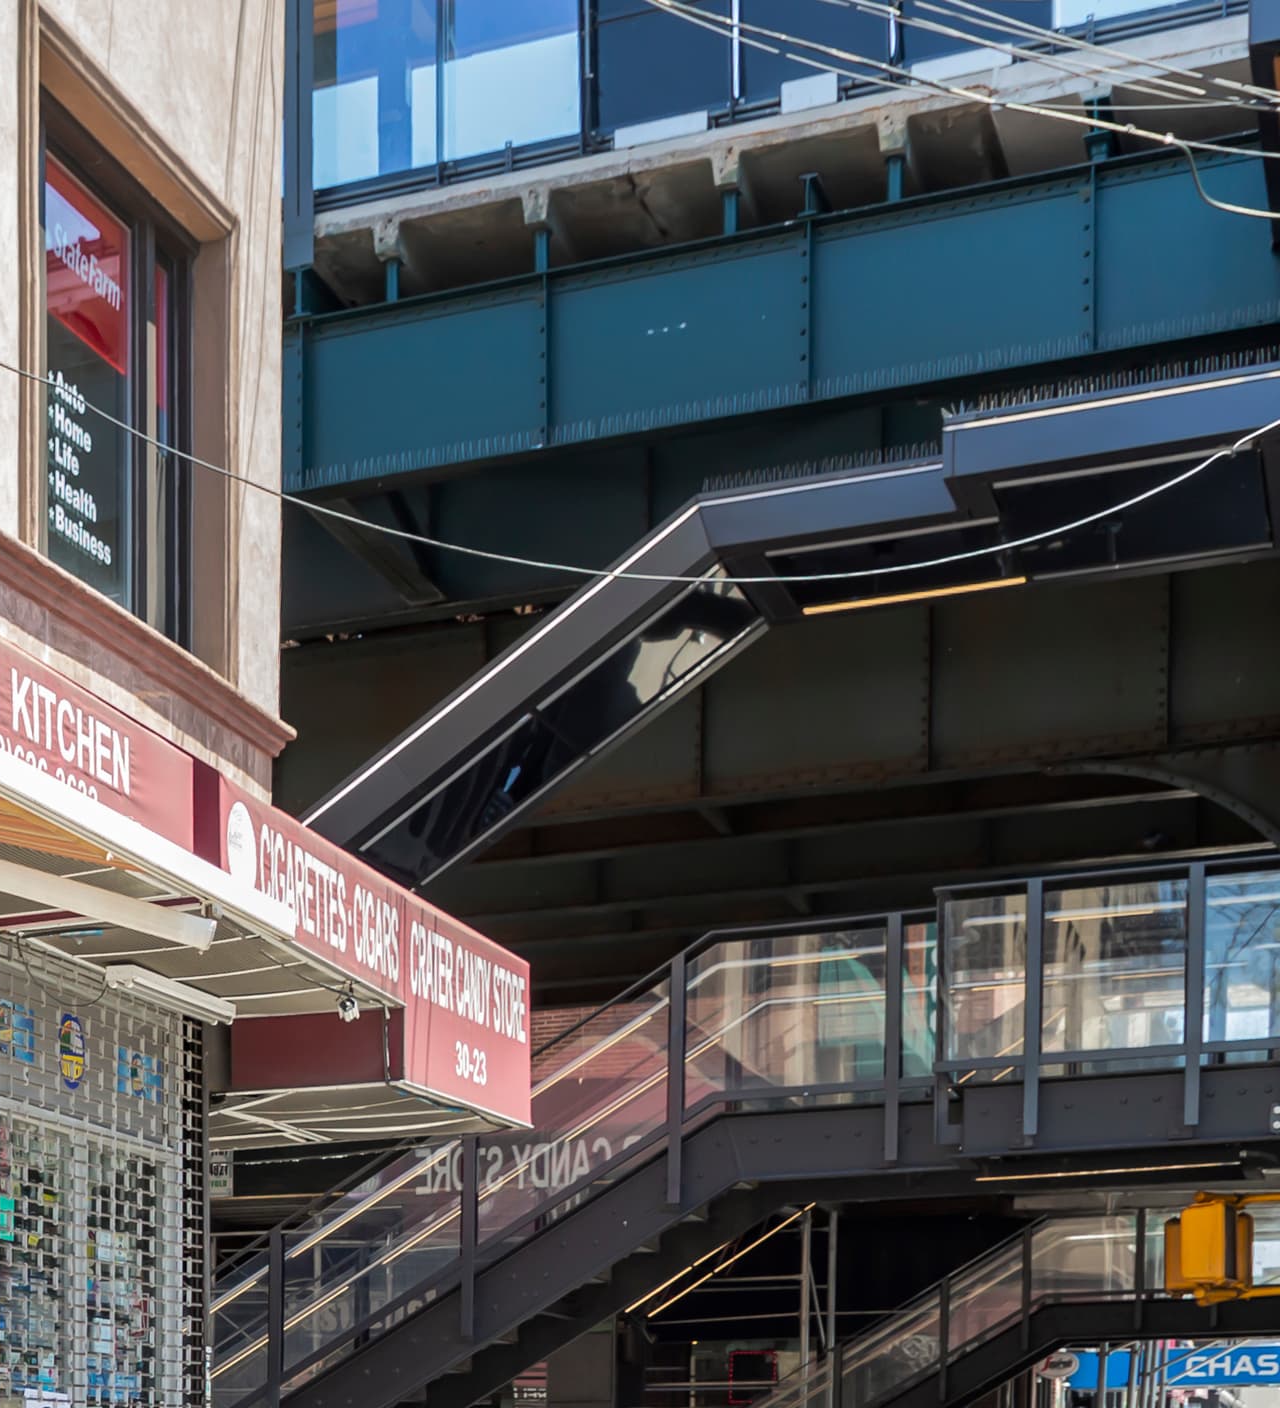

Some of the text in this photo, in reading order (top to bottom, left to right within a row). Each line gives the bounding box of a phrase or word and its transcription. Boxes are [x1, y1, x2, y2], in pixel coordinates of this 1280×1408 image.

[10, 667, 130, 795] KITCHEN
[409, 920, 527, 1044] CRATER CANDY STORE
[455, 1041, 487, 1085] 30-23
[1186, 1354, 1280, 1377] CHAS
